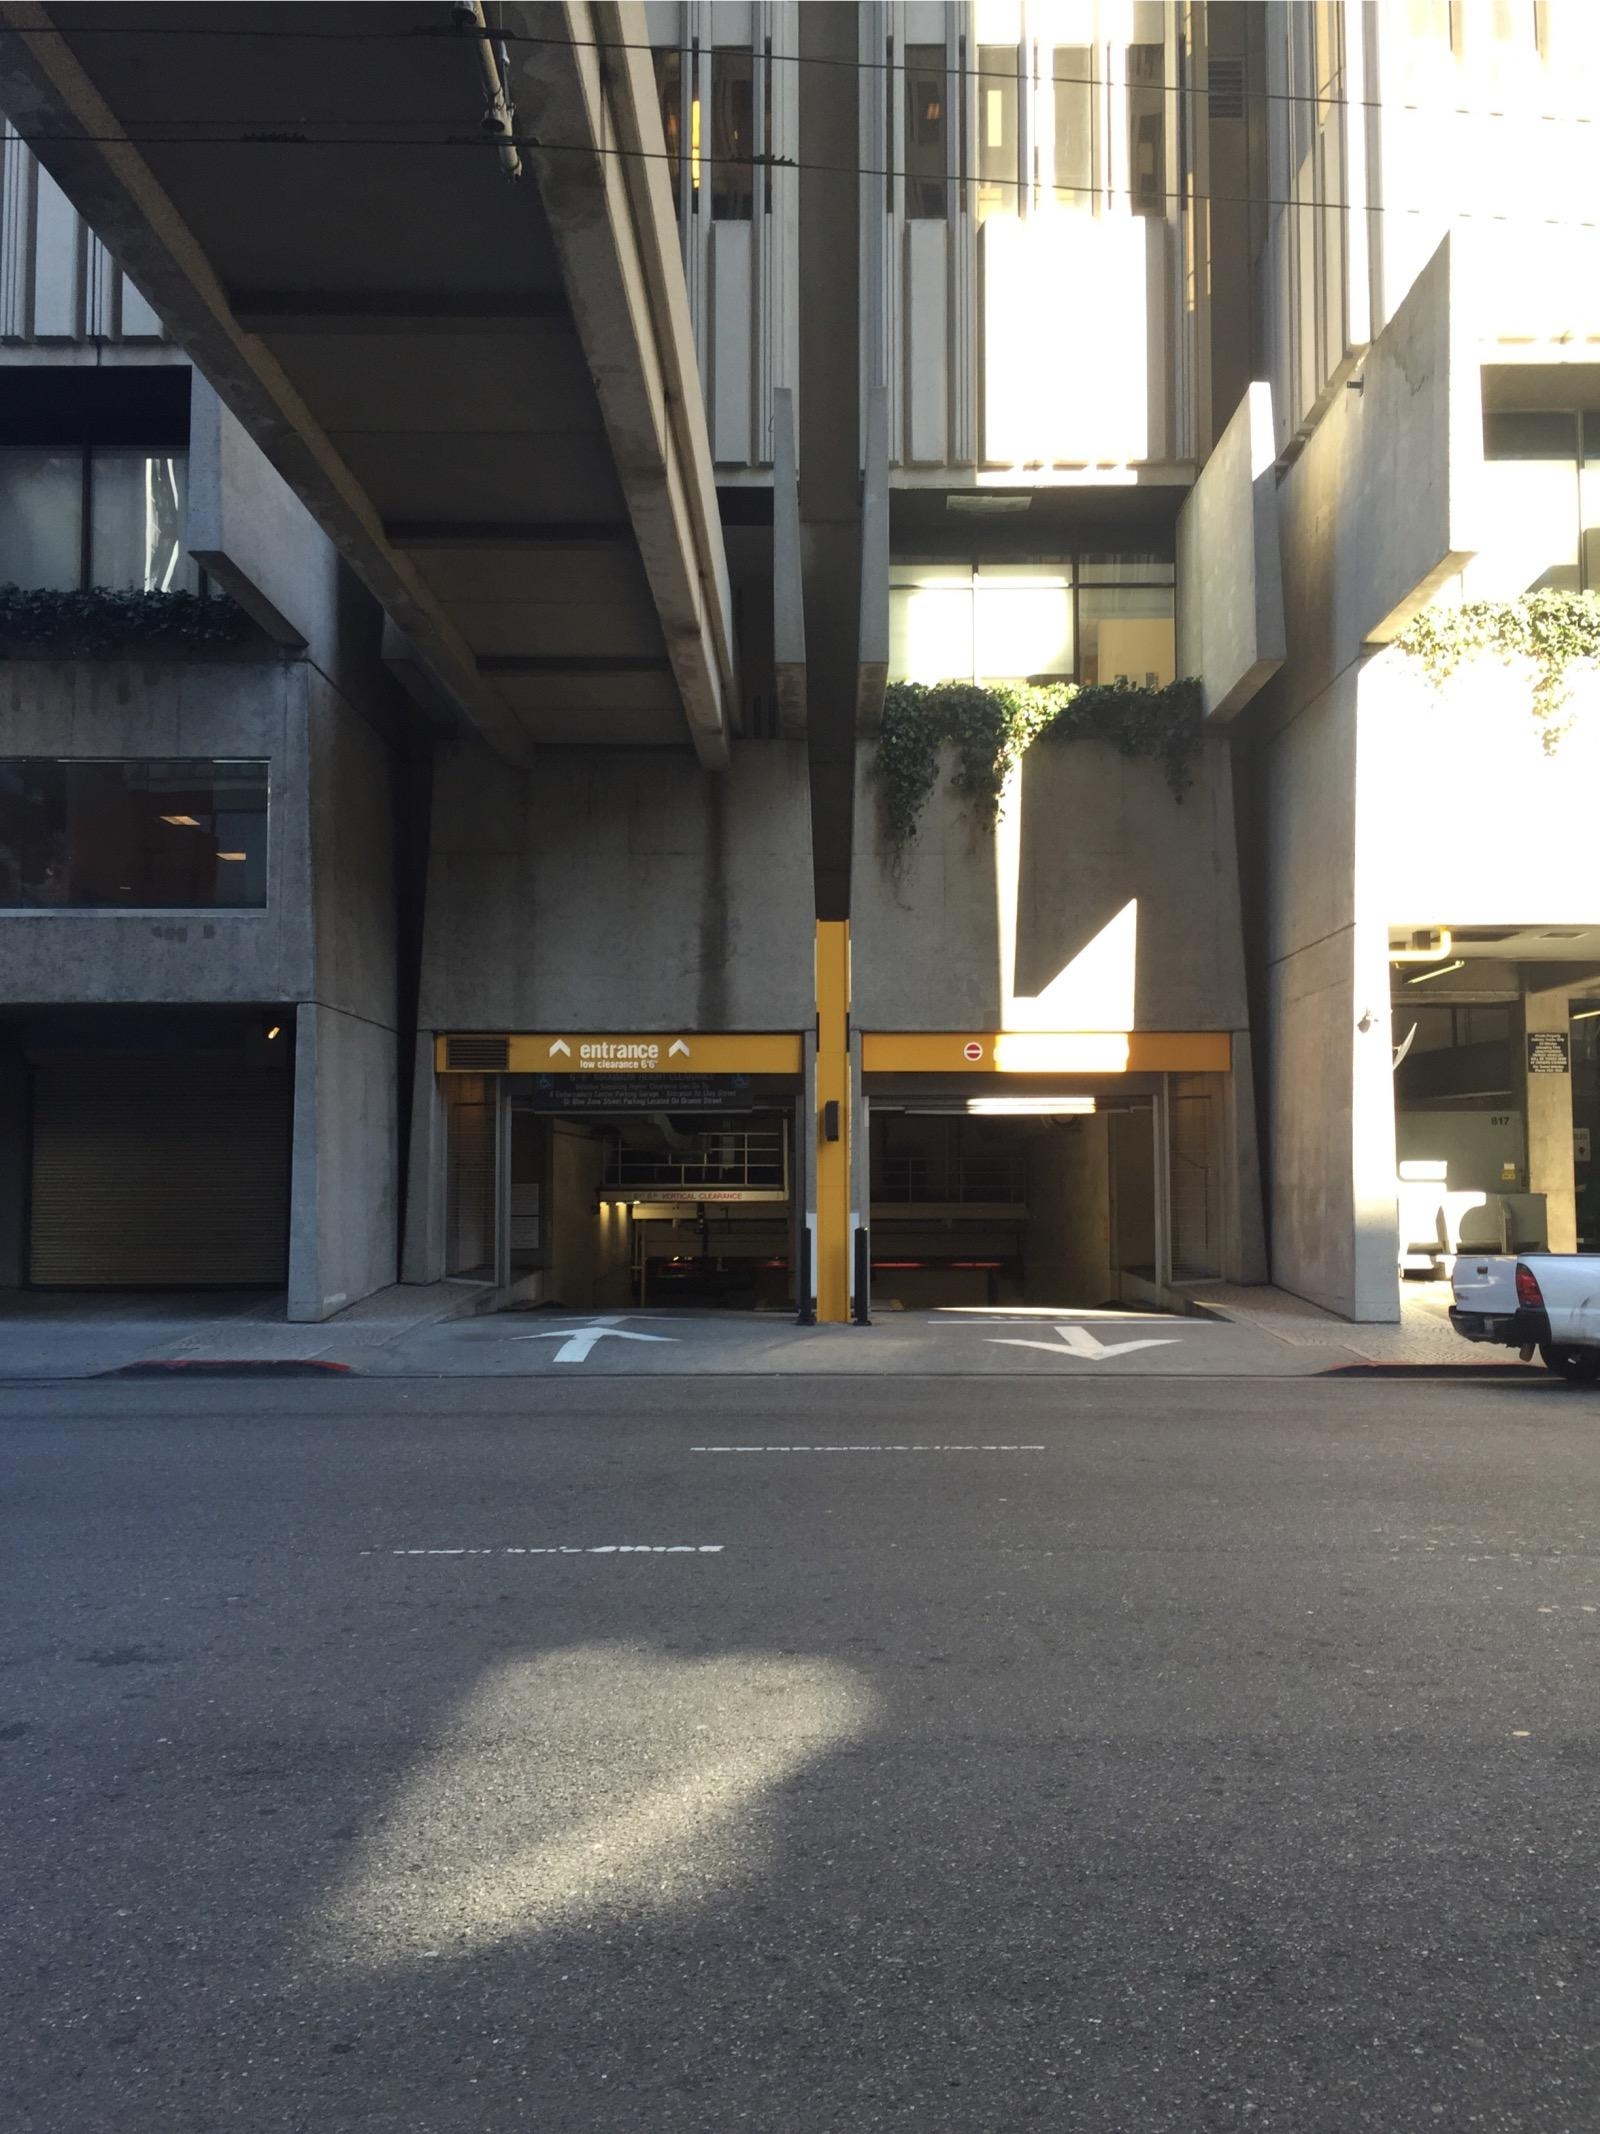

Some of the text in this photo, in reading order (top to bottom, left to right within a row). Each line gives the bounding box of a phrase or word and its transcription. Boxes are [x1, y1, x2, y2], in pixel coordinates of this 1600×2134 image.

[580, 1042, 658, 1058] entrance
[580, 1060, 596, 1068] low
[597, 1060, 638, 1068] clearance
